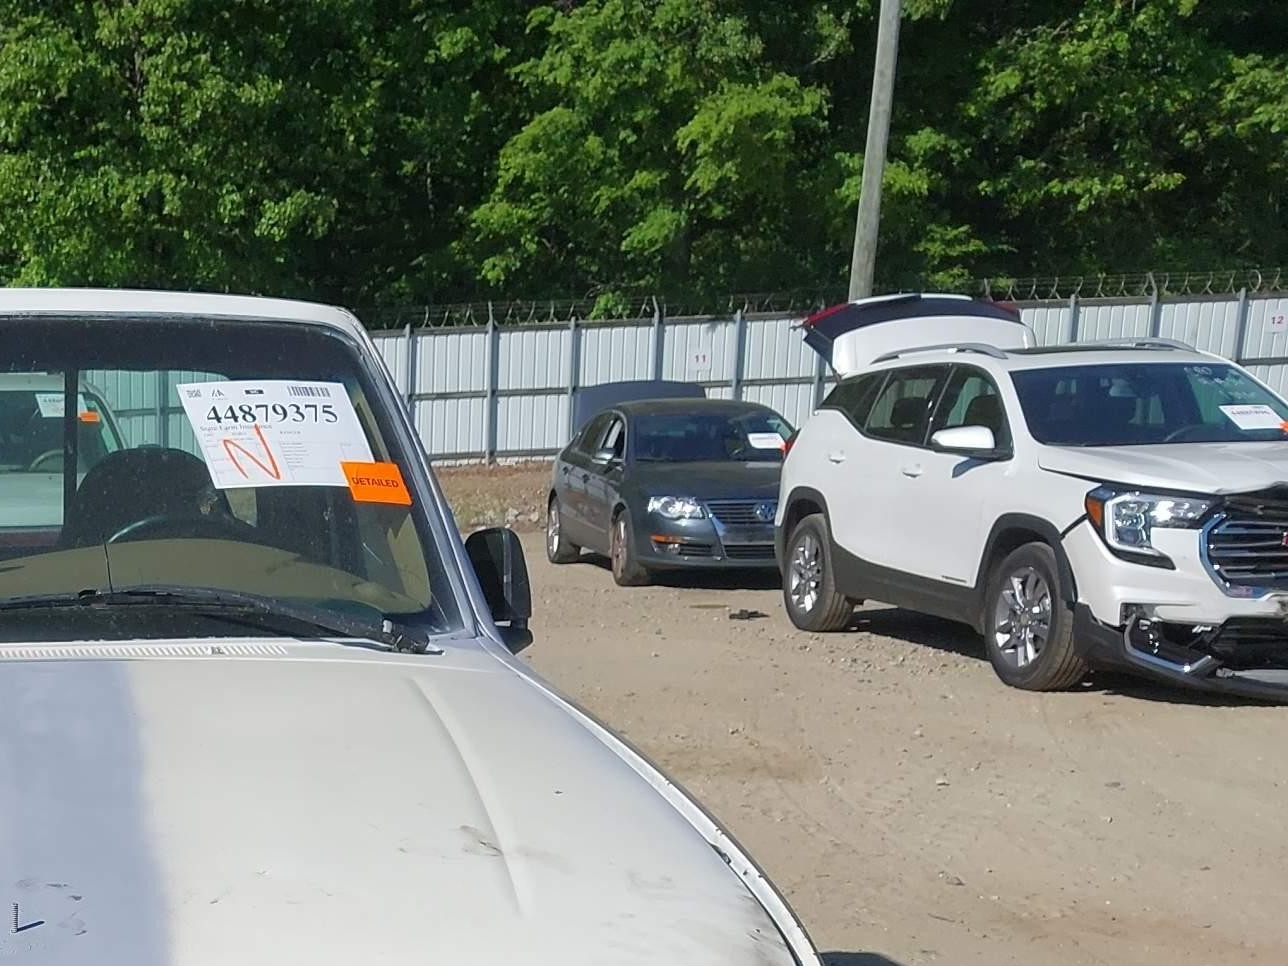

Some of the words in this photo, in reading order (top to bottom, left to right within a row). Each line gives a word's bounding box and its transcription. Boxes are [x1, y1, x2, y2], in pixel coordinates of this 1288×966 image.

[1272, 315, 1284, 325] 12
[695, 354, 706, 363] 11
[206, 403, 338, 424] 44879375
[351, 476, 399, 488] DETAILED
